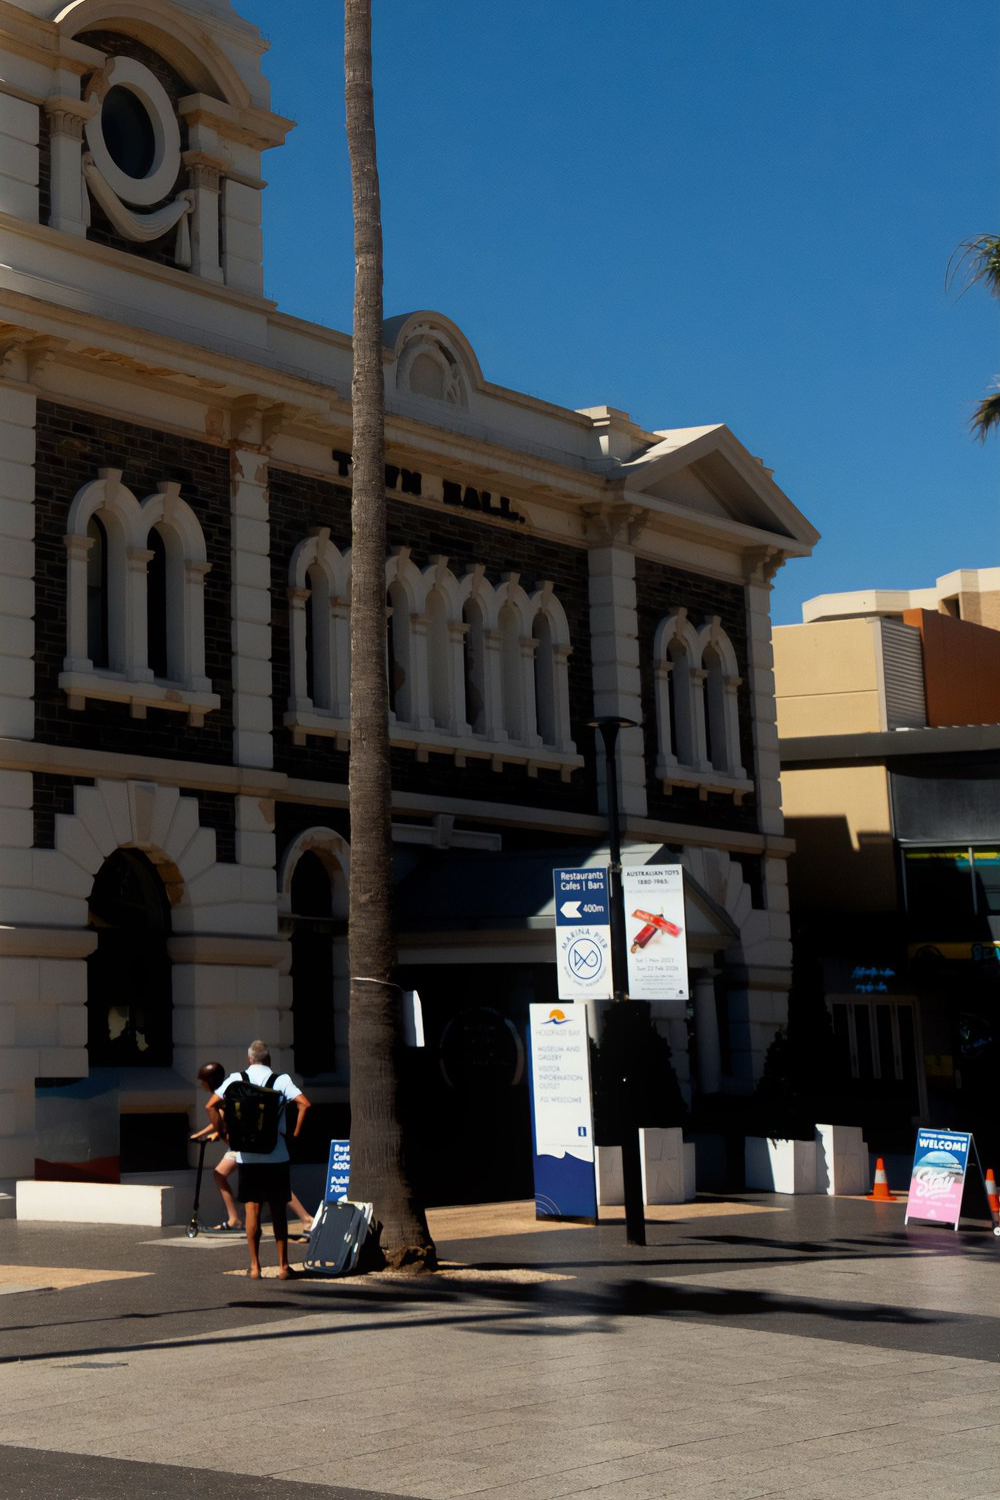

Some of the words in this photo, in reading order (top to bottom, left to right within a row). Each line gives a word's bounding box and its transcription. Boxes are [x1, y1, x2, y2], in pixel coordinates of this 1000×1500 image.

[333, 450, 421, 495] TWN
[561, 872, 603, 880] Restaurants
[561, 882, 580, 890] Cafes
[588, 881, 604, 889] Bars
[583, 904, 604, 912] 400m
[562, 928, 590, 949] MARINA
[594, 932, 608, 948] PIER
[919, 1139, 967, 1152] WELCOME
[915, 1167, 956, 1197] Stay
